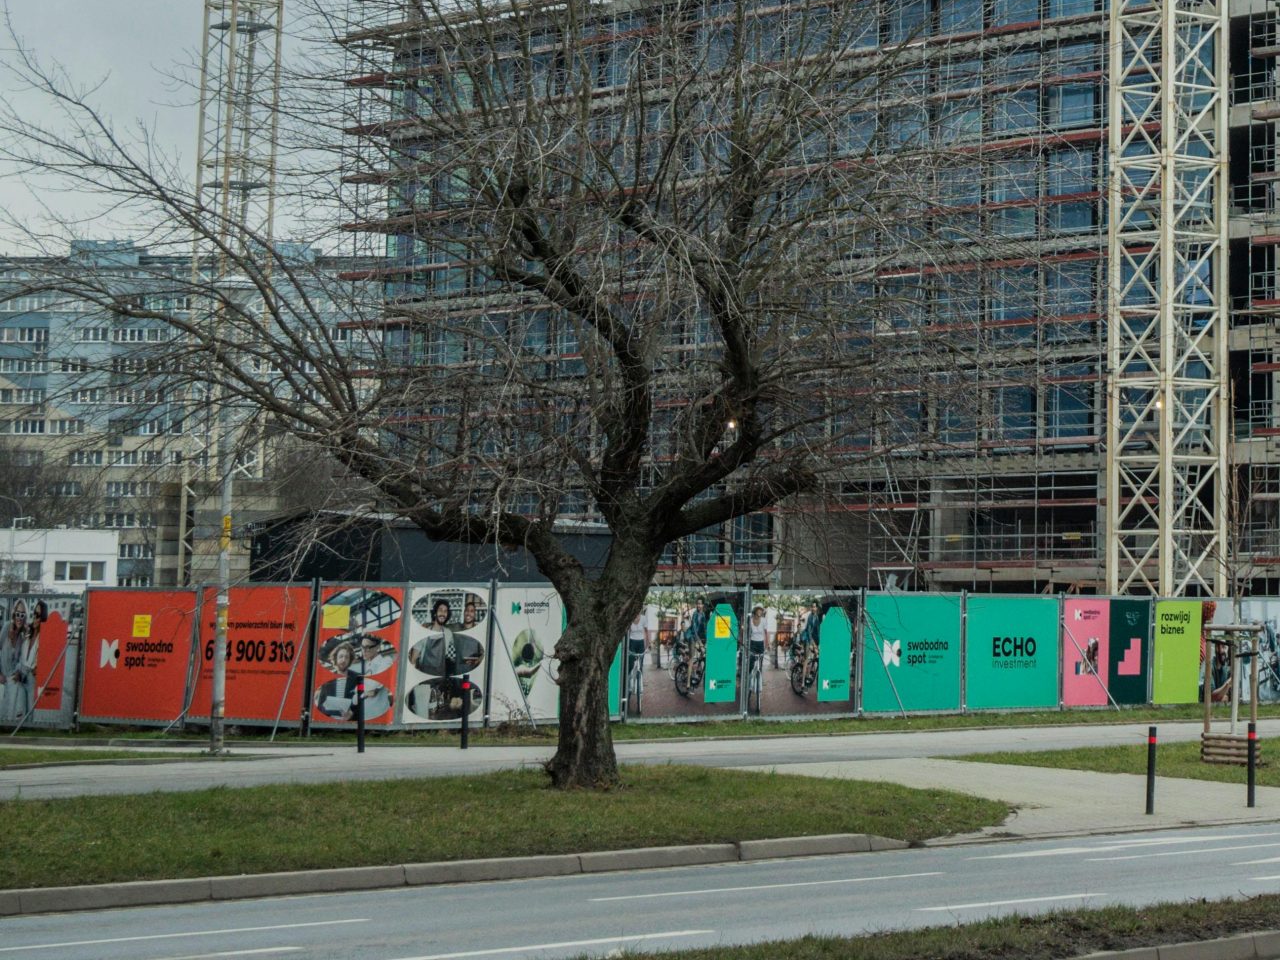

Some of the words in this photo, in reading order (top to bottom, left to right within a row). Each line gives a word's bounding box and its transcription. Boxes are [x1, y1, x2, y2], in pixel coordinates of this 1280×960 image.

[1161, 611, 1190, 623] rozwijaj
[1161, 624, 1184, 634] biznes
[126, 640, 173, 653] swobodna
[205, 639, 232, 661] 64
[236, 639, 266, 662] 900
[269, 640, 295, 662] 310
[907, 639, 949, 650] swobodna
[992, 636, 1036, 657] ECHO
[124, 654, 145, 669] spot
[907, 652, 926, 666] spot
[992, 658, 1036, 669] investment
